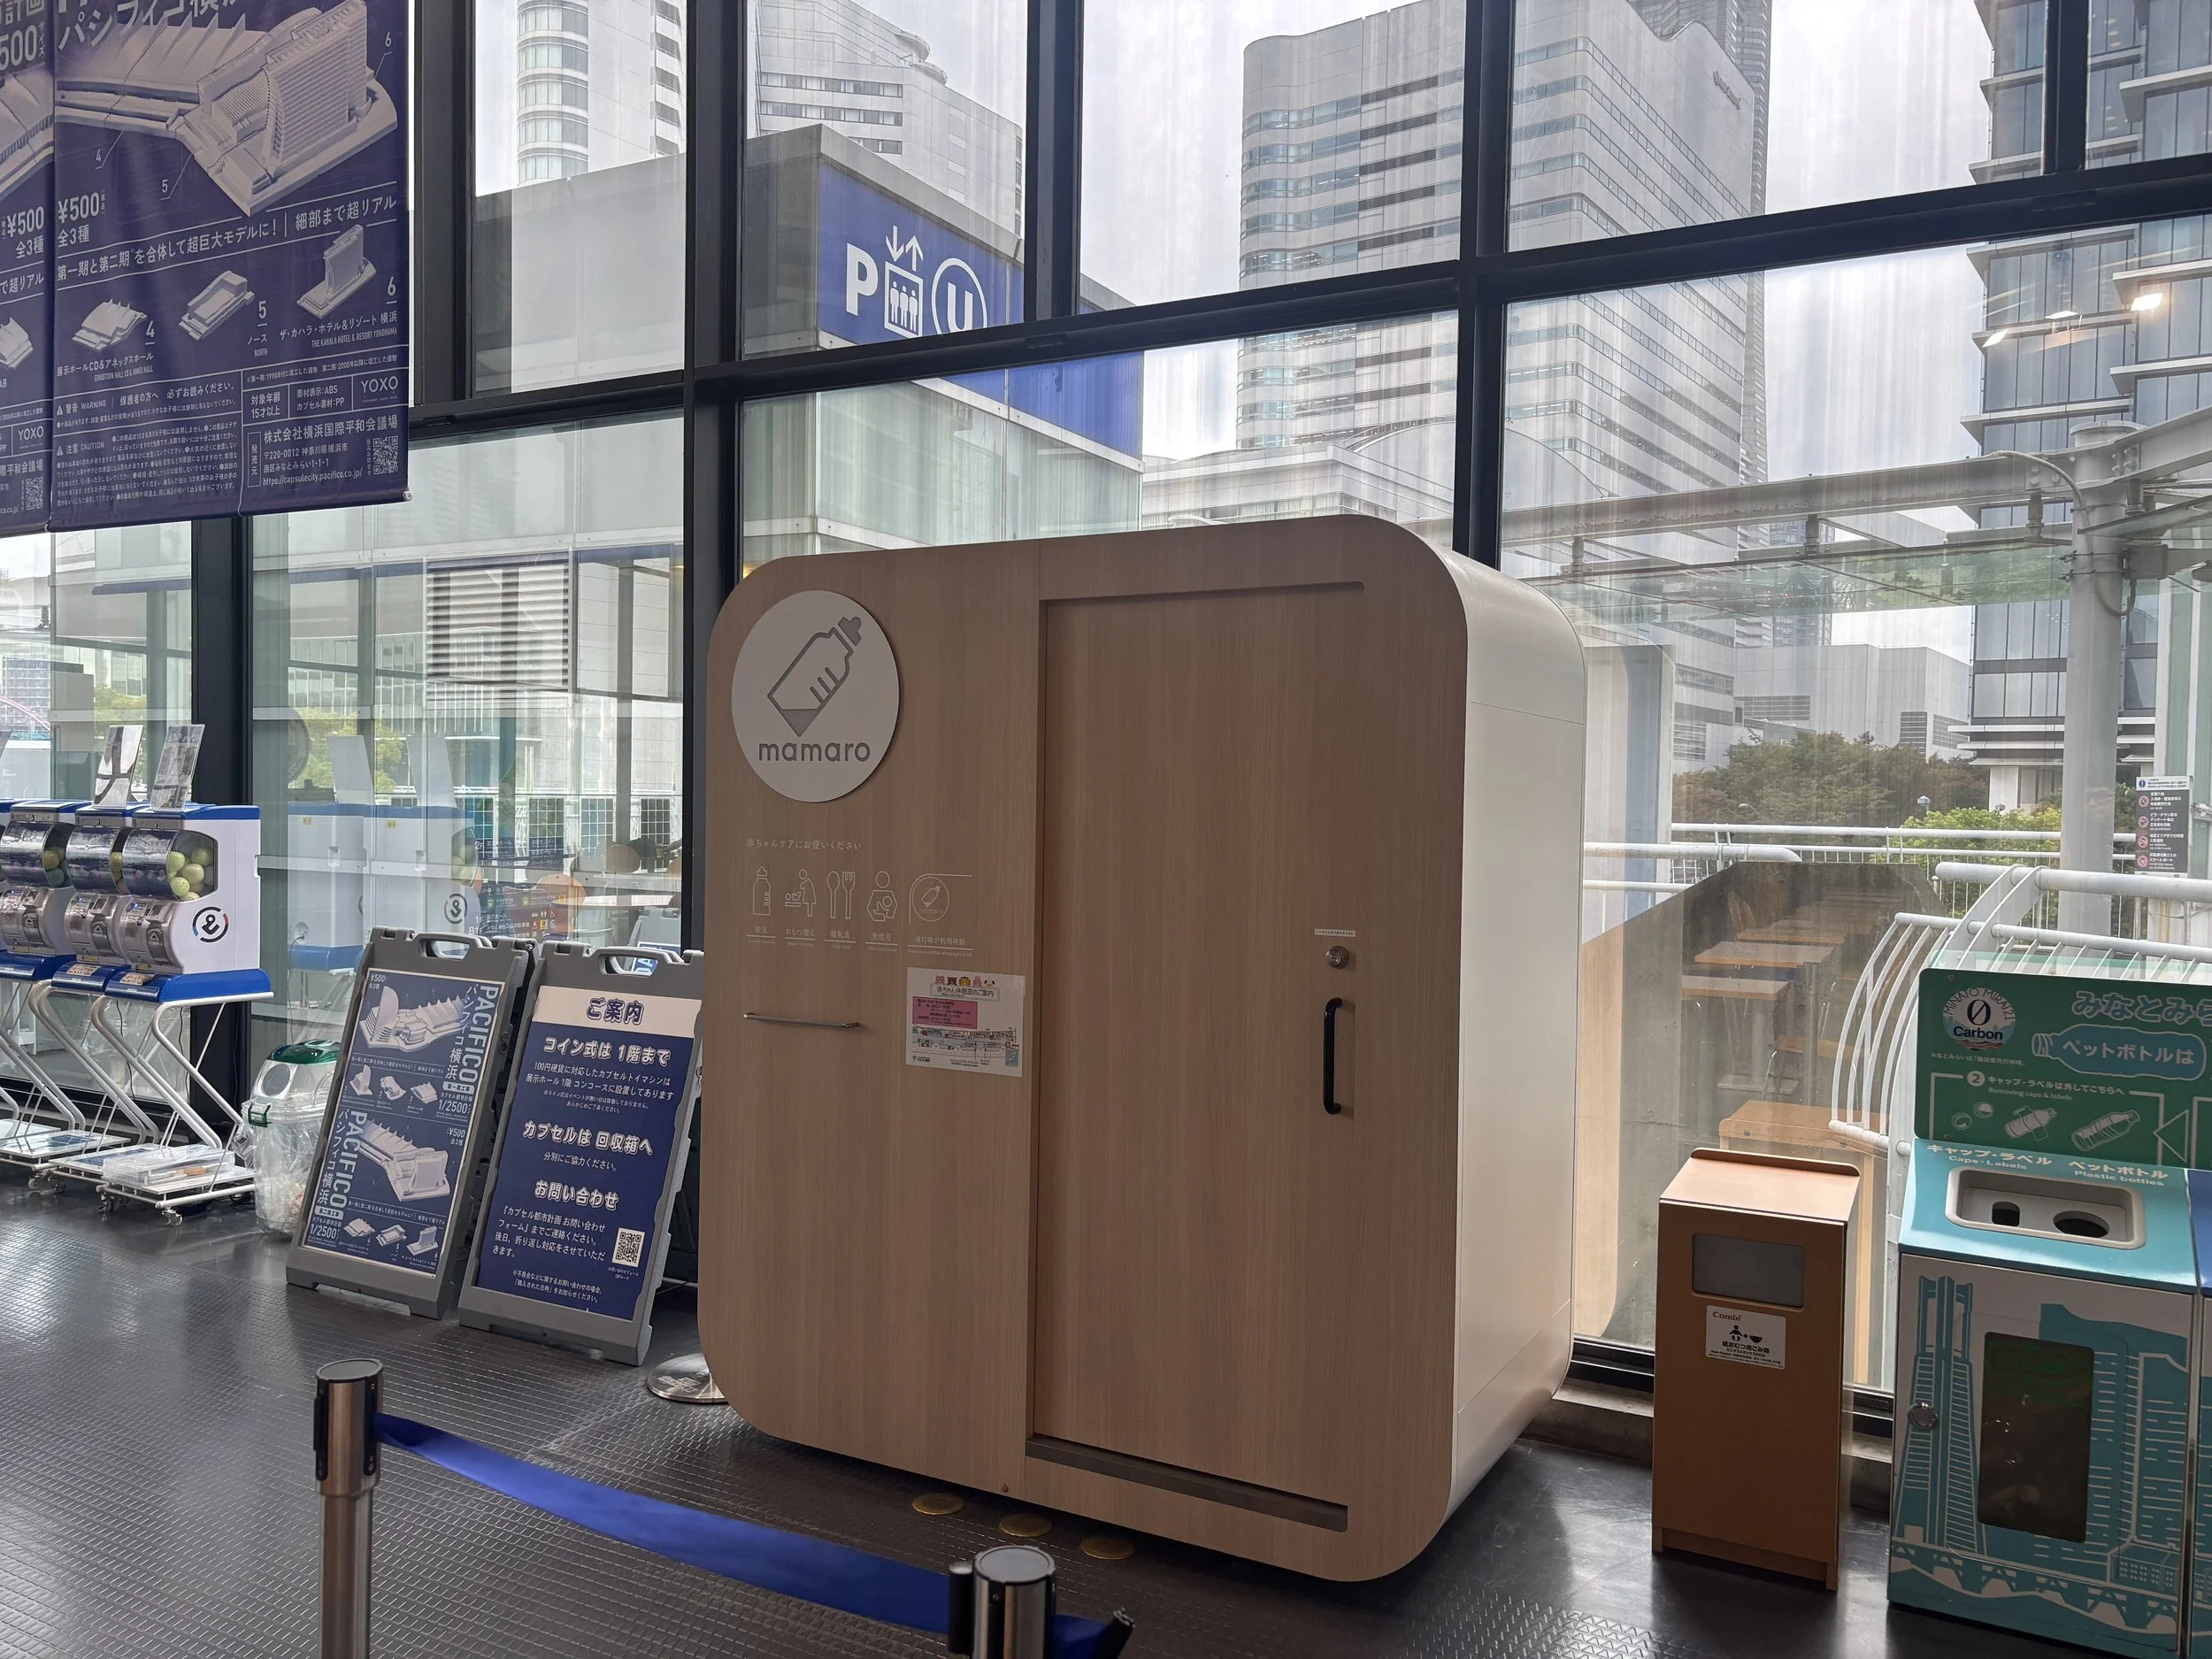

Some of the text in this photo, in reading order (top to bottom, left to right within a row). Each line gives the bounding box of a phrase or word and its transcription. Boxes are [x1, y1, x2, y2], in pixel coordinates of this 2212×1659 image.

[162, 180, 168, 193] 5
[58, 192, 99, 223] ¥500
[296, 196, 397, 231] 細部まで超リアル
[7, 206, 44, 237] ¥500
[16, 234, 44, 259] 全3種
[58, 225, 89, 248] 全3種
[388, 276, 396, 296] 6
[846, 242, 879, 316] P
[258, 301, 267, 319] 5
[380, 311, 397, 324] 横浜
[145, 320, 155, 337] 4
[247, 334, 267, 345] ノース
[361, 375, 398, 394] YOXO
[81, 399, 106, 411] WARNING
[18, 426, 44, 441] YOXO
[264, 414, 398, 444] 株式会社横浜国際平和会議場
[81, 442, 104, 451] CAUTION
[302, 442, 348, 457] 神奈川県横浜市
[758, 741, 871, 763] mamaro
[587, 997, 644, 1025] ご案内
[1944, 987, 1979, 1016] MINATO
[445, 983, 480, 1080] パシフィコ横浜
[458, 985, 499, 1083] PACIFICO
[1953, 1026, 2003, 1041] Carbon
[543, 1036, 672, 1067] コイン式は 1階まで
[2062, 1040, 2195, 1065] ペットボトルは
[534, 1062, 672, 1087] 100円硬貨に対応したカプセルトイマシンは
[526, 1073, 675, 1101] 展示ホール 1階 コンコースに設置してあります
[1988, 1087, 2024, 1097] Removing
[2050, 1092, 2073, 1101] labels
[439, 1099, 468, 1114] 1/2500
[523, 1120, 653, 1156] カプセルは 回収箱へ
[317, 1109, 350, 1205] パシフィコ横浜
[329, 1110, 368, 1209] PACIFICO
[543, 1151, 617, 1171] 分別にご協力ください。
[1926, 1143, 2053, 1165] キャップ・ラベル
[2074, 1170, 2117, 1181] Plastic
[2119, 1175, 2165, 1187] bottles
[534, 1179, 619, 1211] お問い合わせ
[310, 1223, 337, 1240] 1/2500
[563, 1216, 606, 1233] お問い合わせ
[492, 1245, 516, 1258] きます。
[1713, 1311, 1740, 1322] Combi
